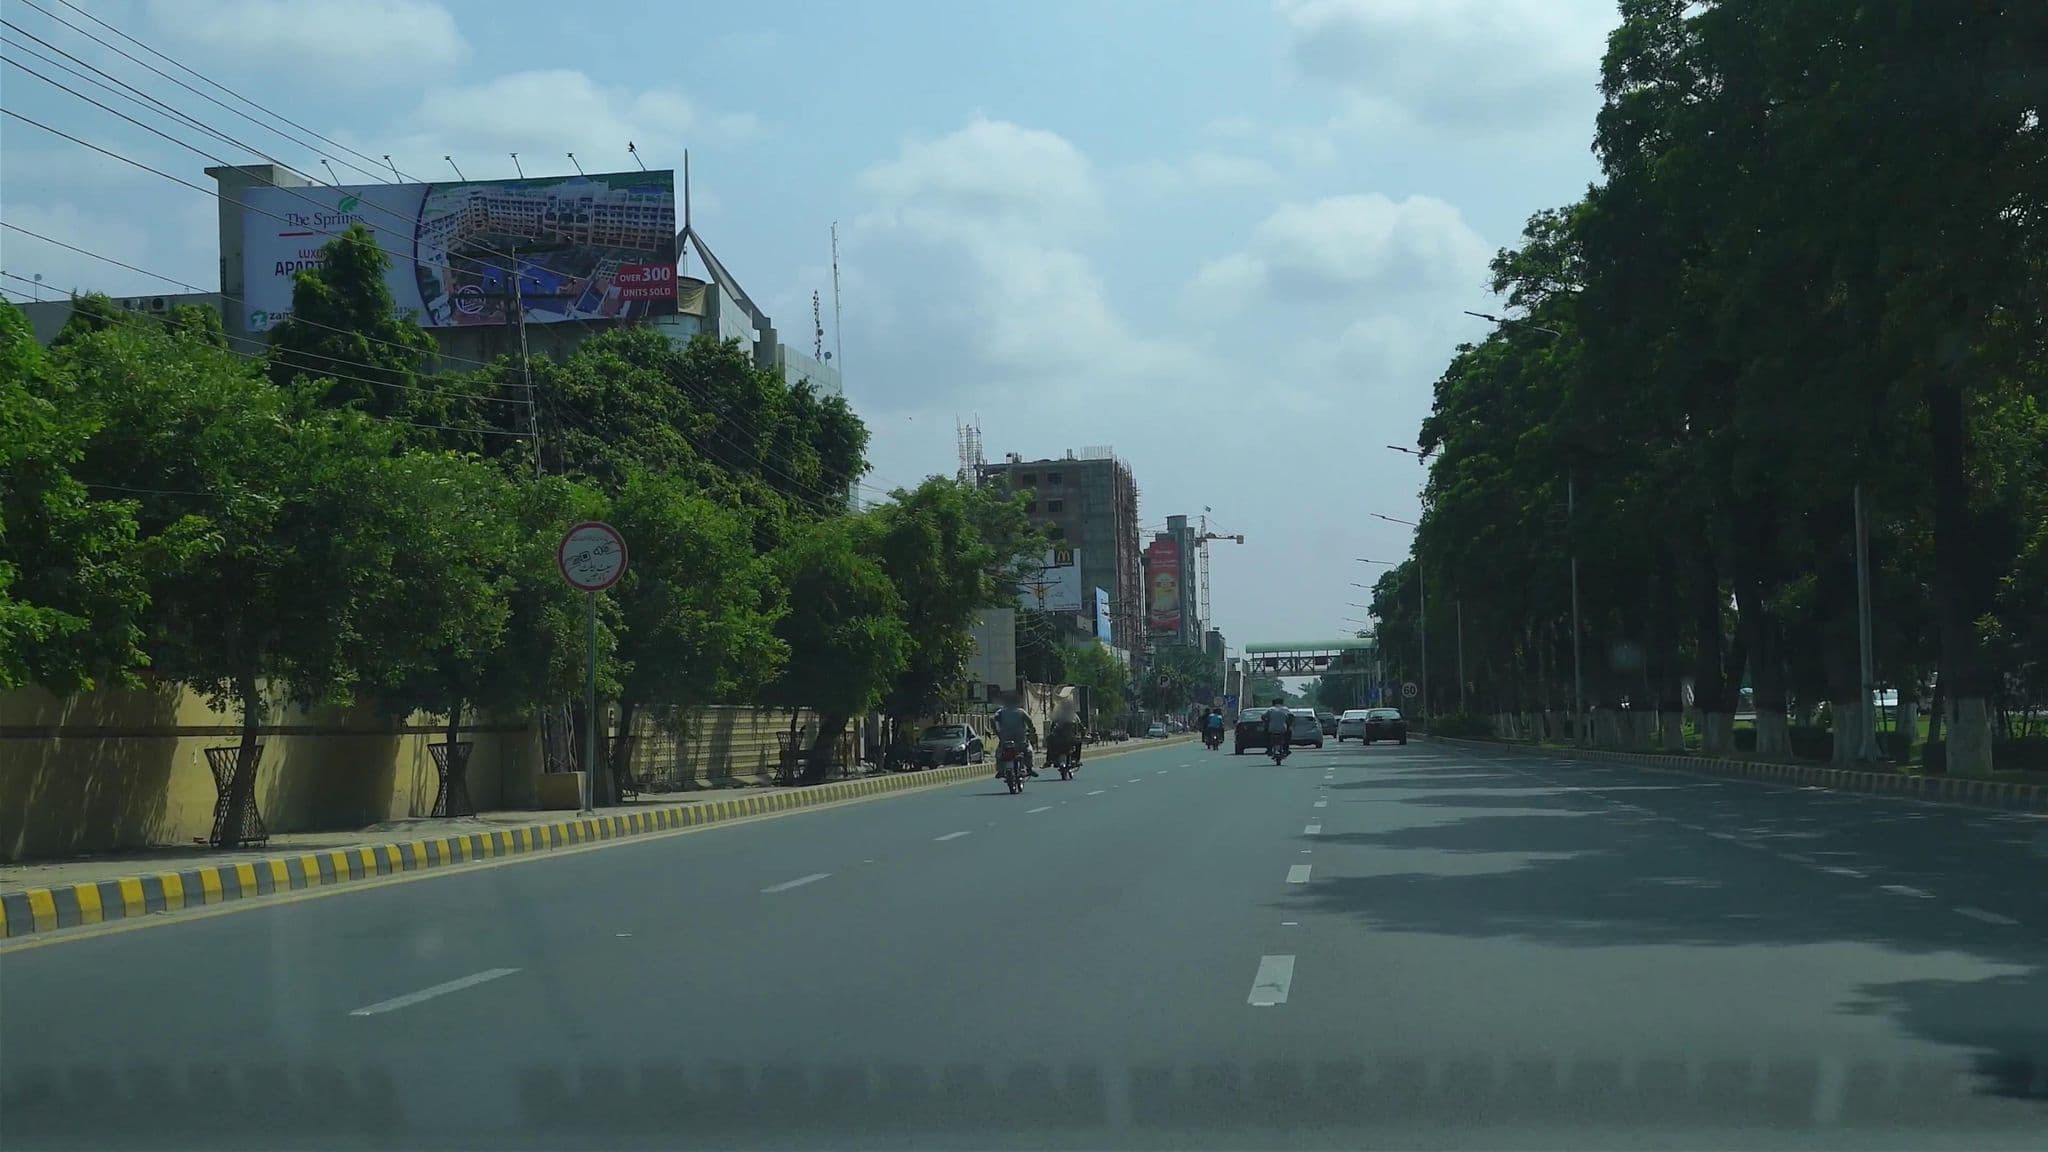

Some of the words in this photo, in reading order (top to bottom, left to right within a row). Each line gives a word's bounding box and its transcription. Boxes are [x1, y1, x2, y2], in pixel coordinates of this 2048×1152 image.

[285, 213, 310, 226] The
[620, 274, 641, 282] OVER
[642, 267, 671, 281] 300
[623, 288, 648, 297] UNITS
[649, 287, 671, 295] SOLD
[1404, 686, 1415, 694] 60
